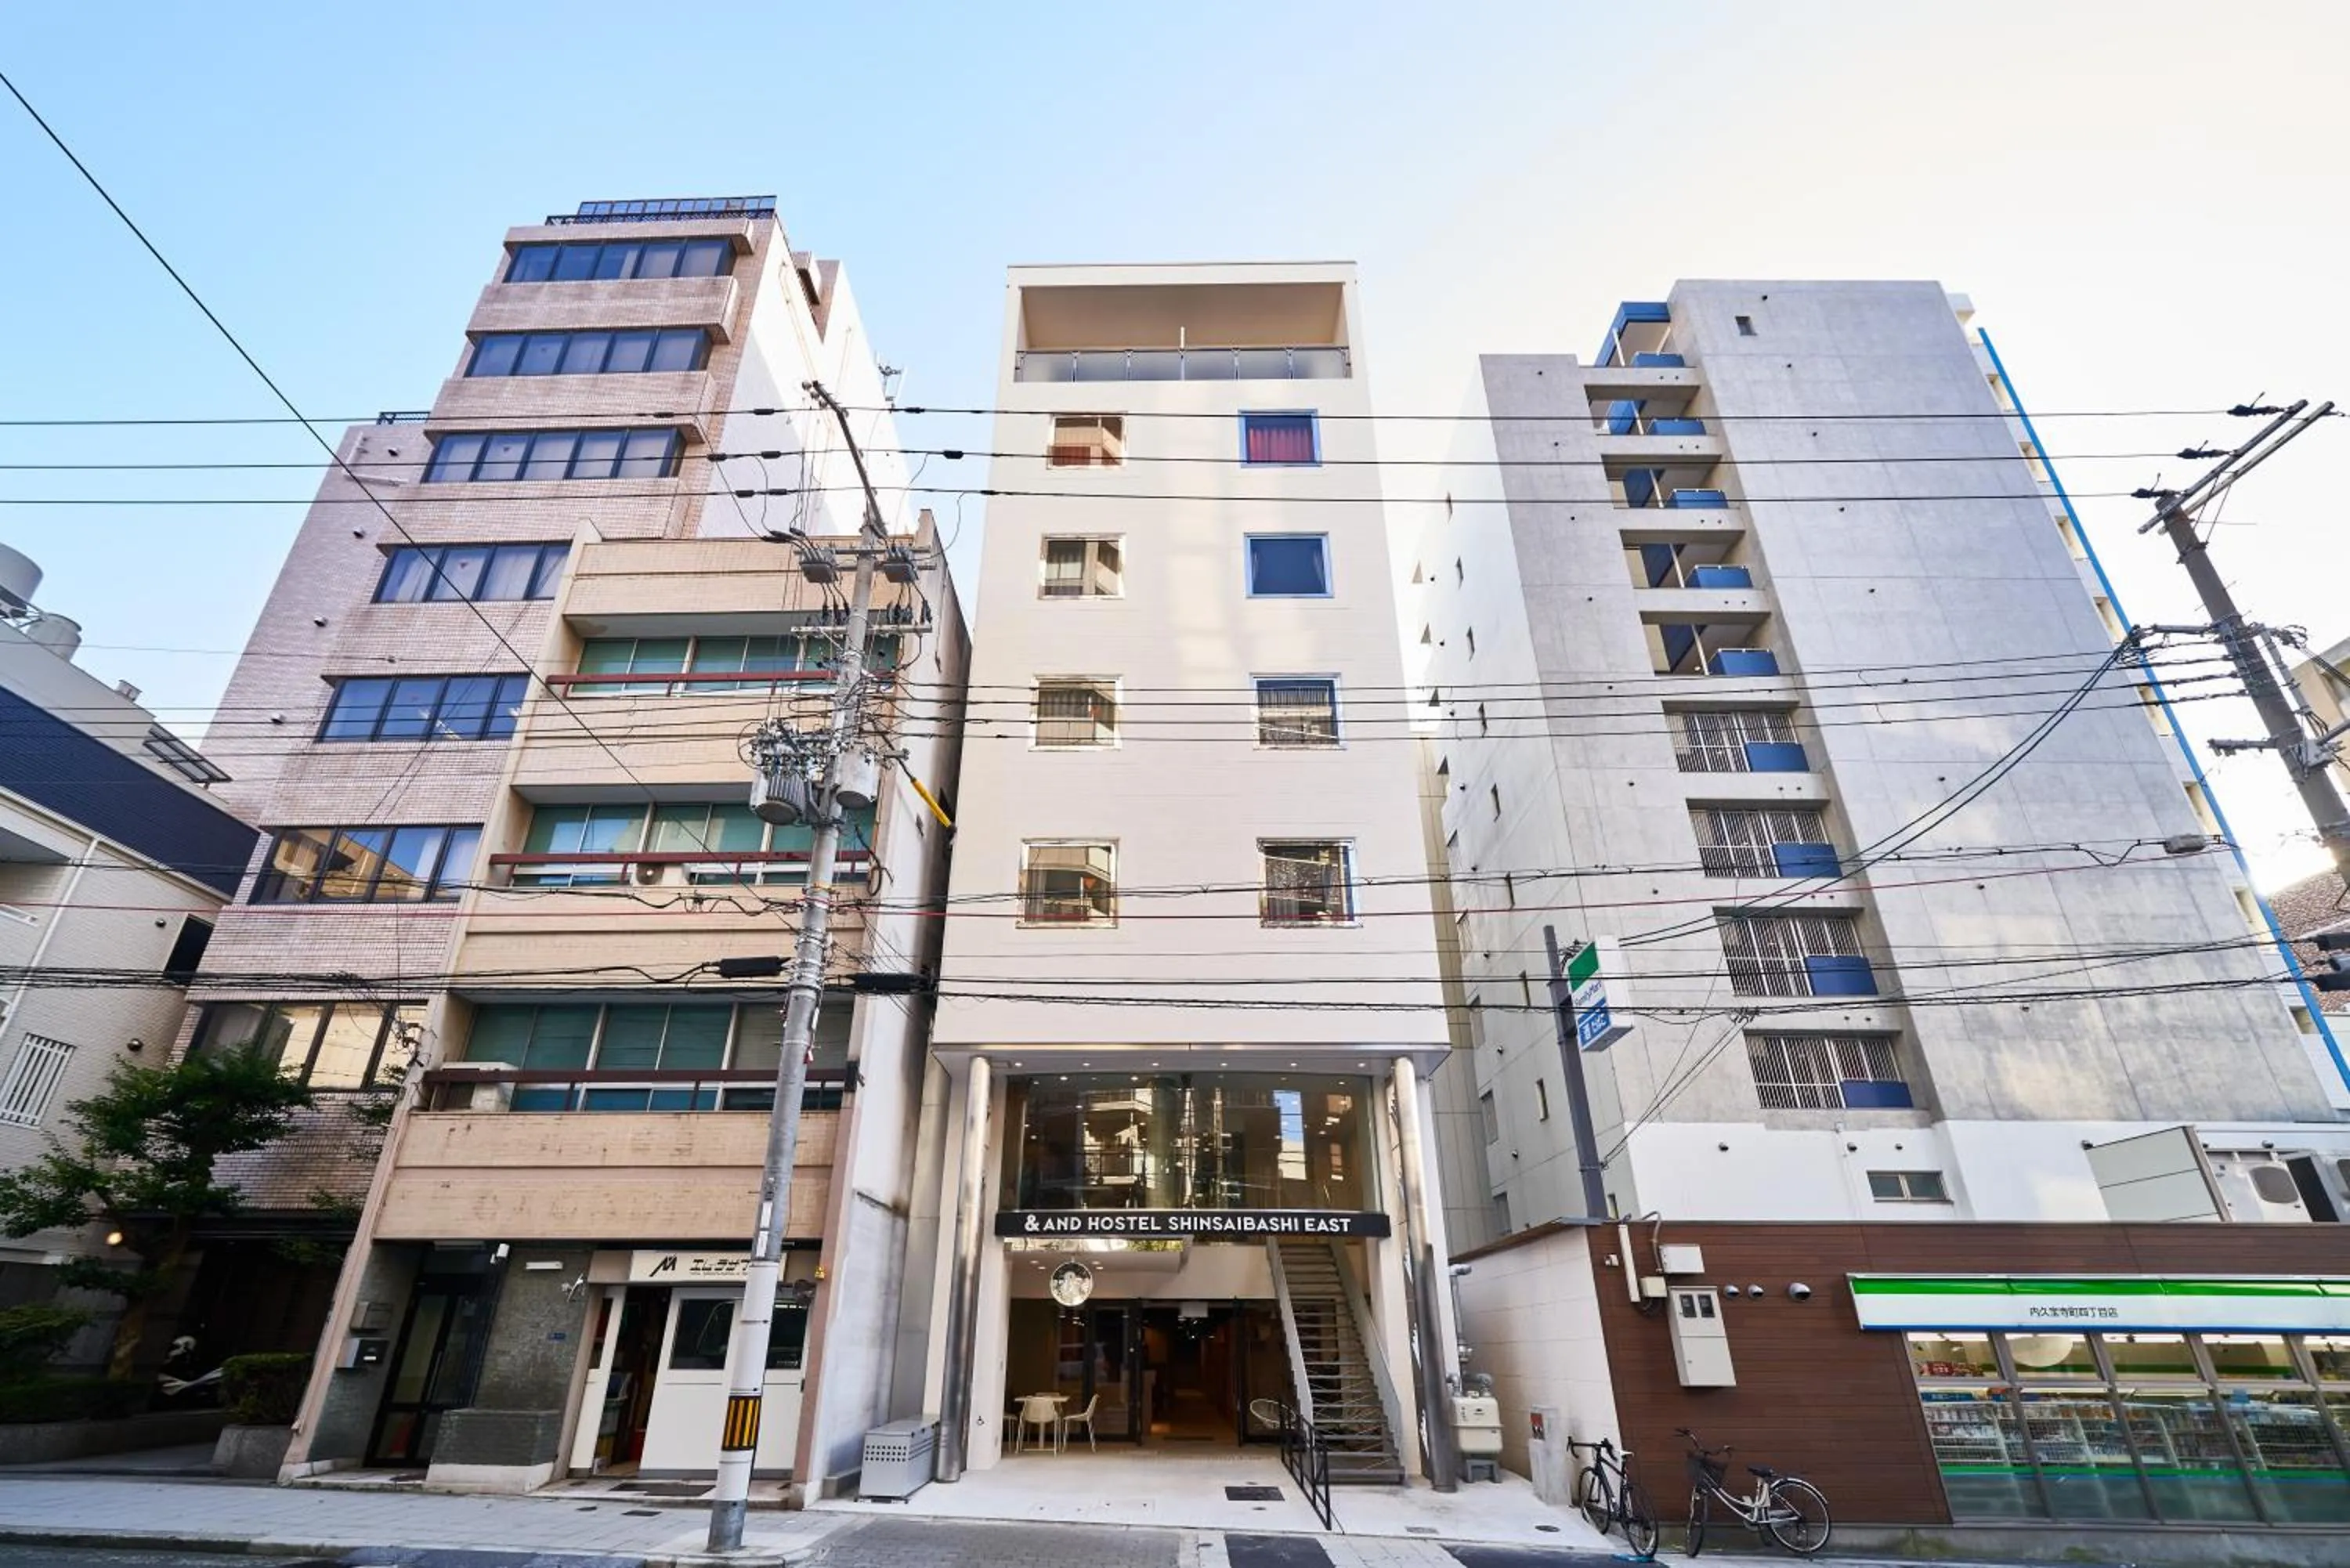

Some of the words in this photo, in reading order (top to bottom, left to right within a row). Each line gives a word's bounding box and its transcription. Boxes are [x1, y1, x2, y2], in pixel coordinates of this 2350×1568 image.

[1025, 1215, 1039, 1232] &
[1043, 1216, 1082, 1230] AND
[1087, 1216, 1162, 1230] HOSTEL
[1168, 1216, 1299, 1231] SHINSAIBASHI
[1304, 1218, 1351, 1232] EAST
